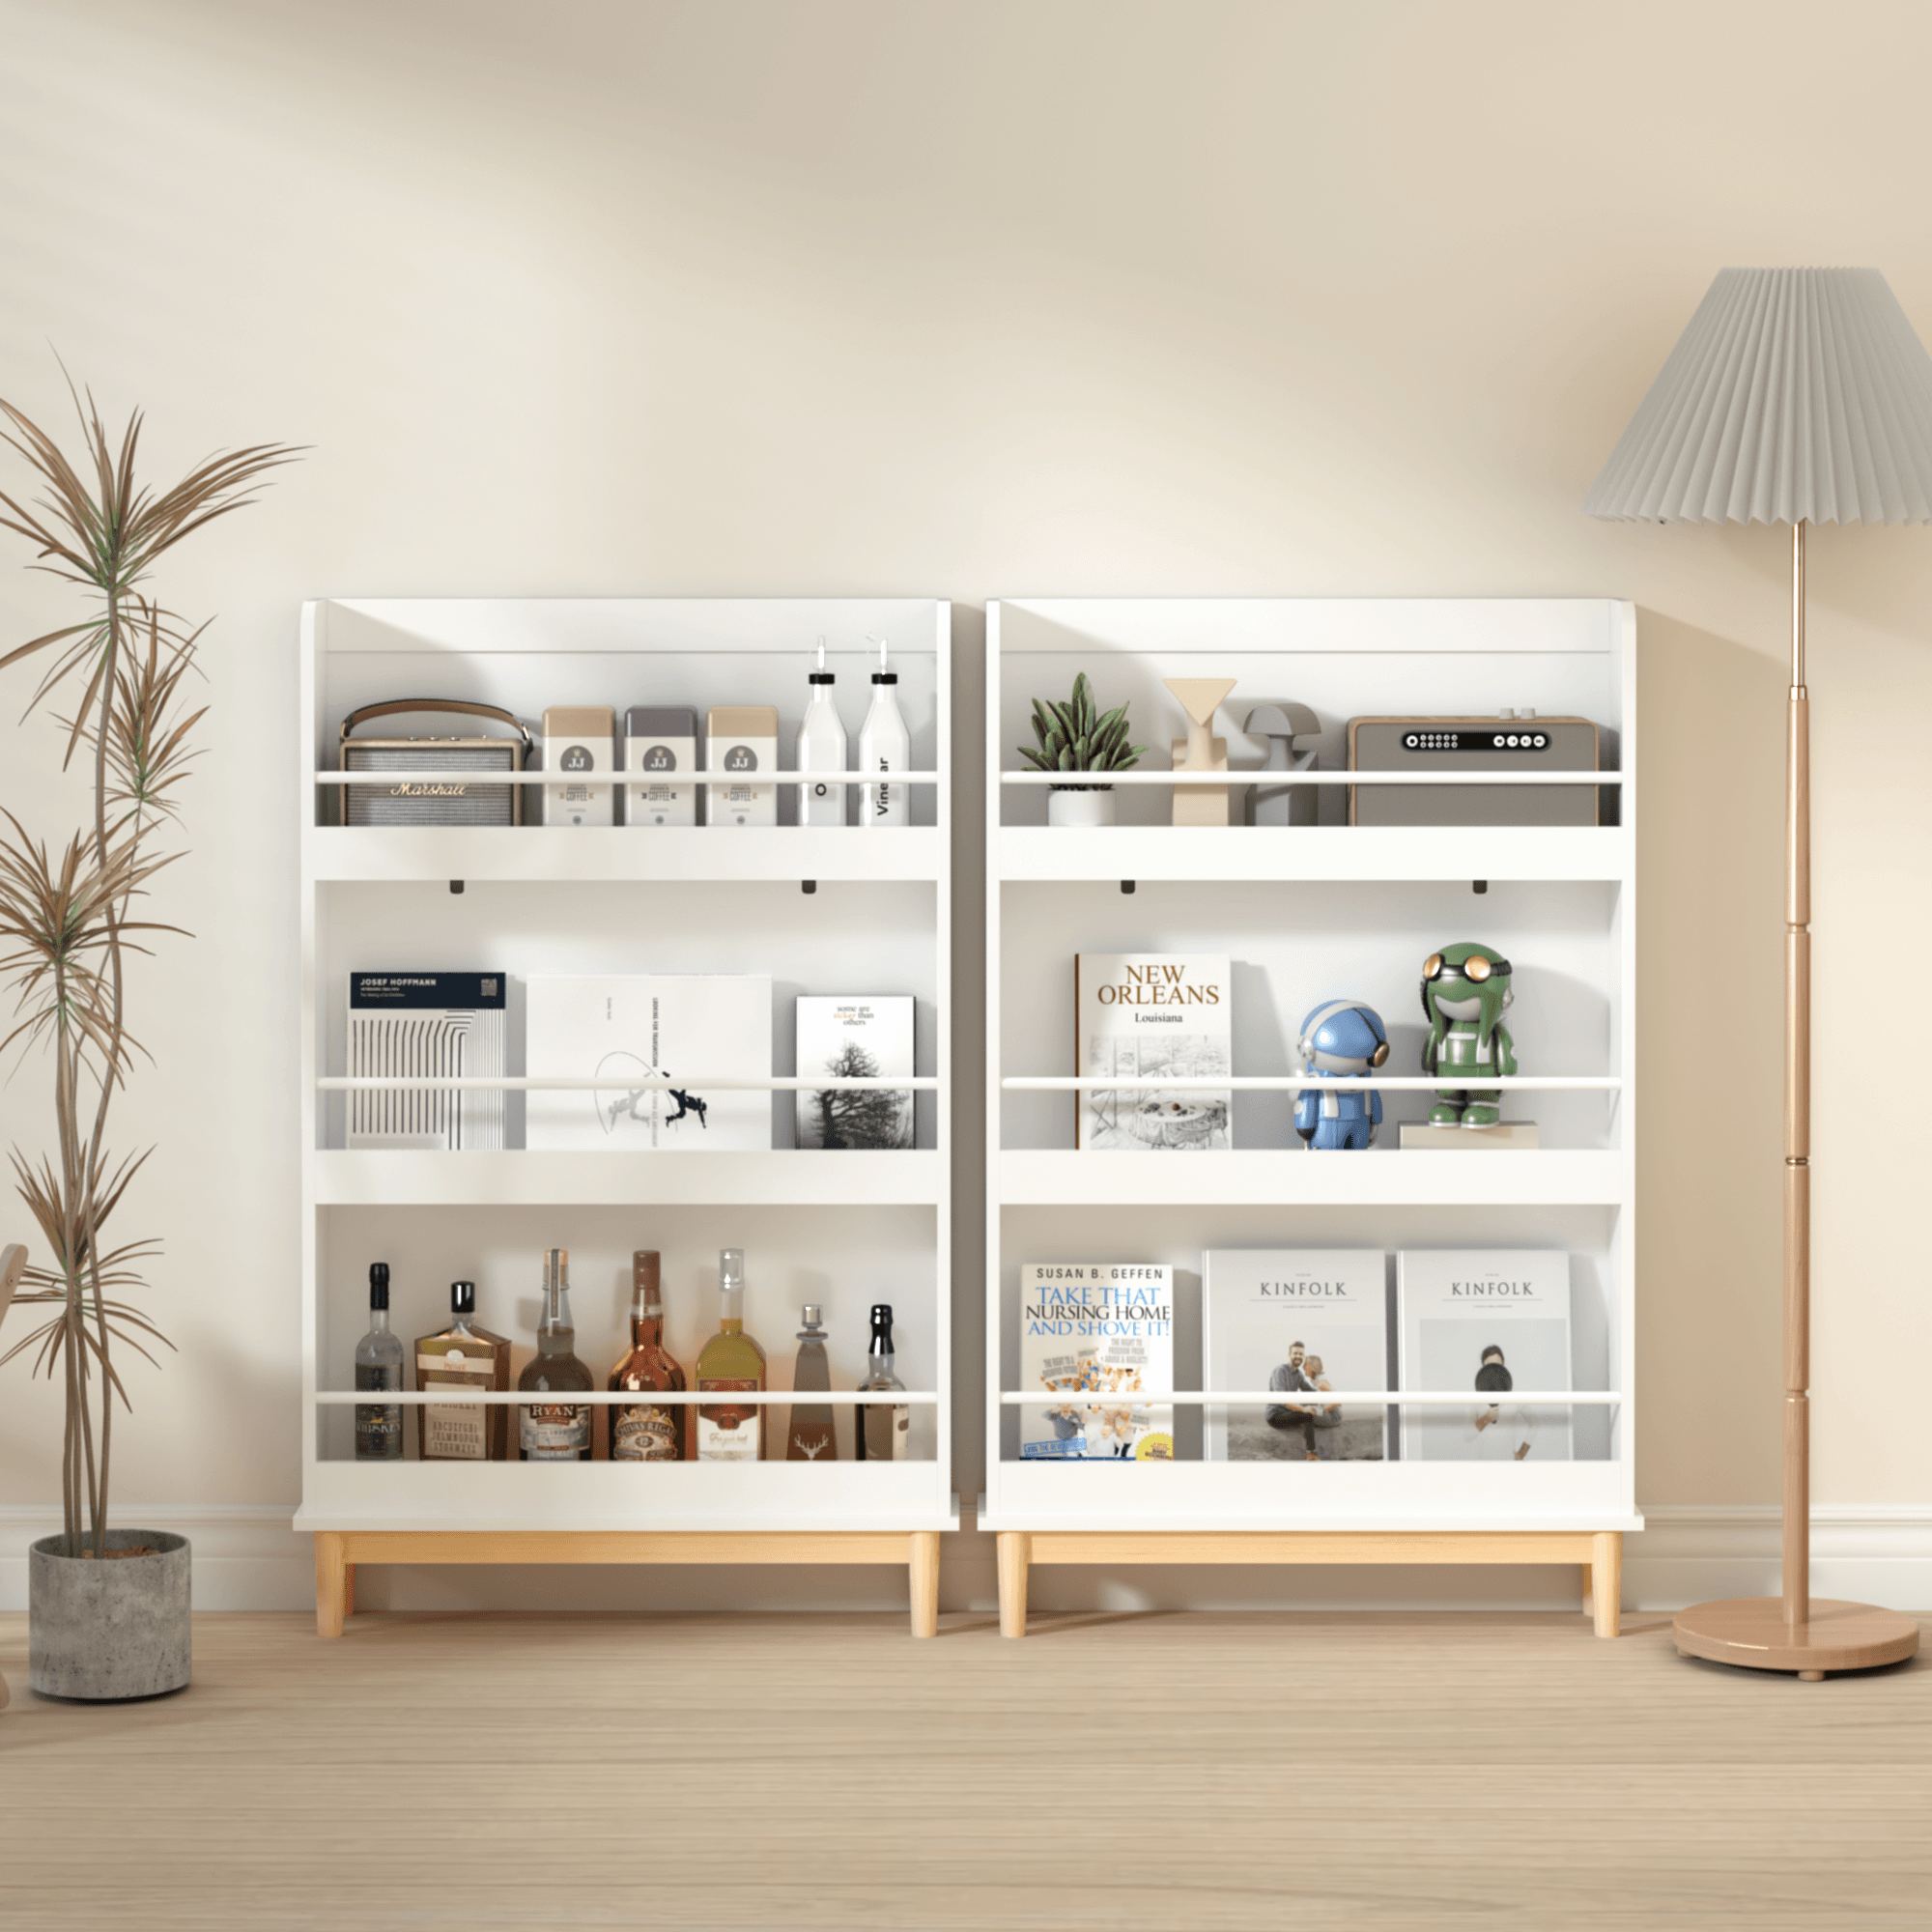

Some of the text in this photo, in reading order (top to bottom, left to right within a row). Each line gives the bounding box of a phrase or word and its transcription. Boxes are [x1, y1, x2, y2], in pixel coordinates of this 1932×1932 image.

[390, 782, 469, 796] Marshall
[876, 757, 889, 816] Vinear
[565, 791, 588, 802] COFFEE
[647, 791, 670, 802] COFFEE
[728, 791, 752, 802] COFFEE
[1125, 965, 1185, 984] NEW
[1097, 984, 1220, 1006] ORLEANS
[1135, 1012, 1183, 1023] Louisiana
[1037, 1268, 1163, 1279] SUSAN B. GEFFEN
[1260, 1282, 1347, 1295] KINFOLK
[1451, 1282, 1533, 1295] KINFOLK
[1036, 1287, 1160, 1305] TAKE THAT
[1026, 1305, 1170, 1320] NURSING HOME
[1027, 1321, 1170, 1336] AND SHOVE IT!
[533, 1406, 574, 1416] RYAN
